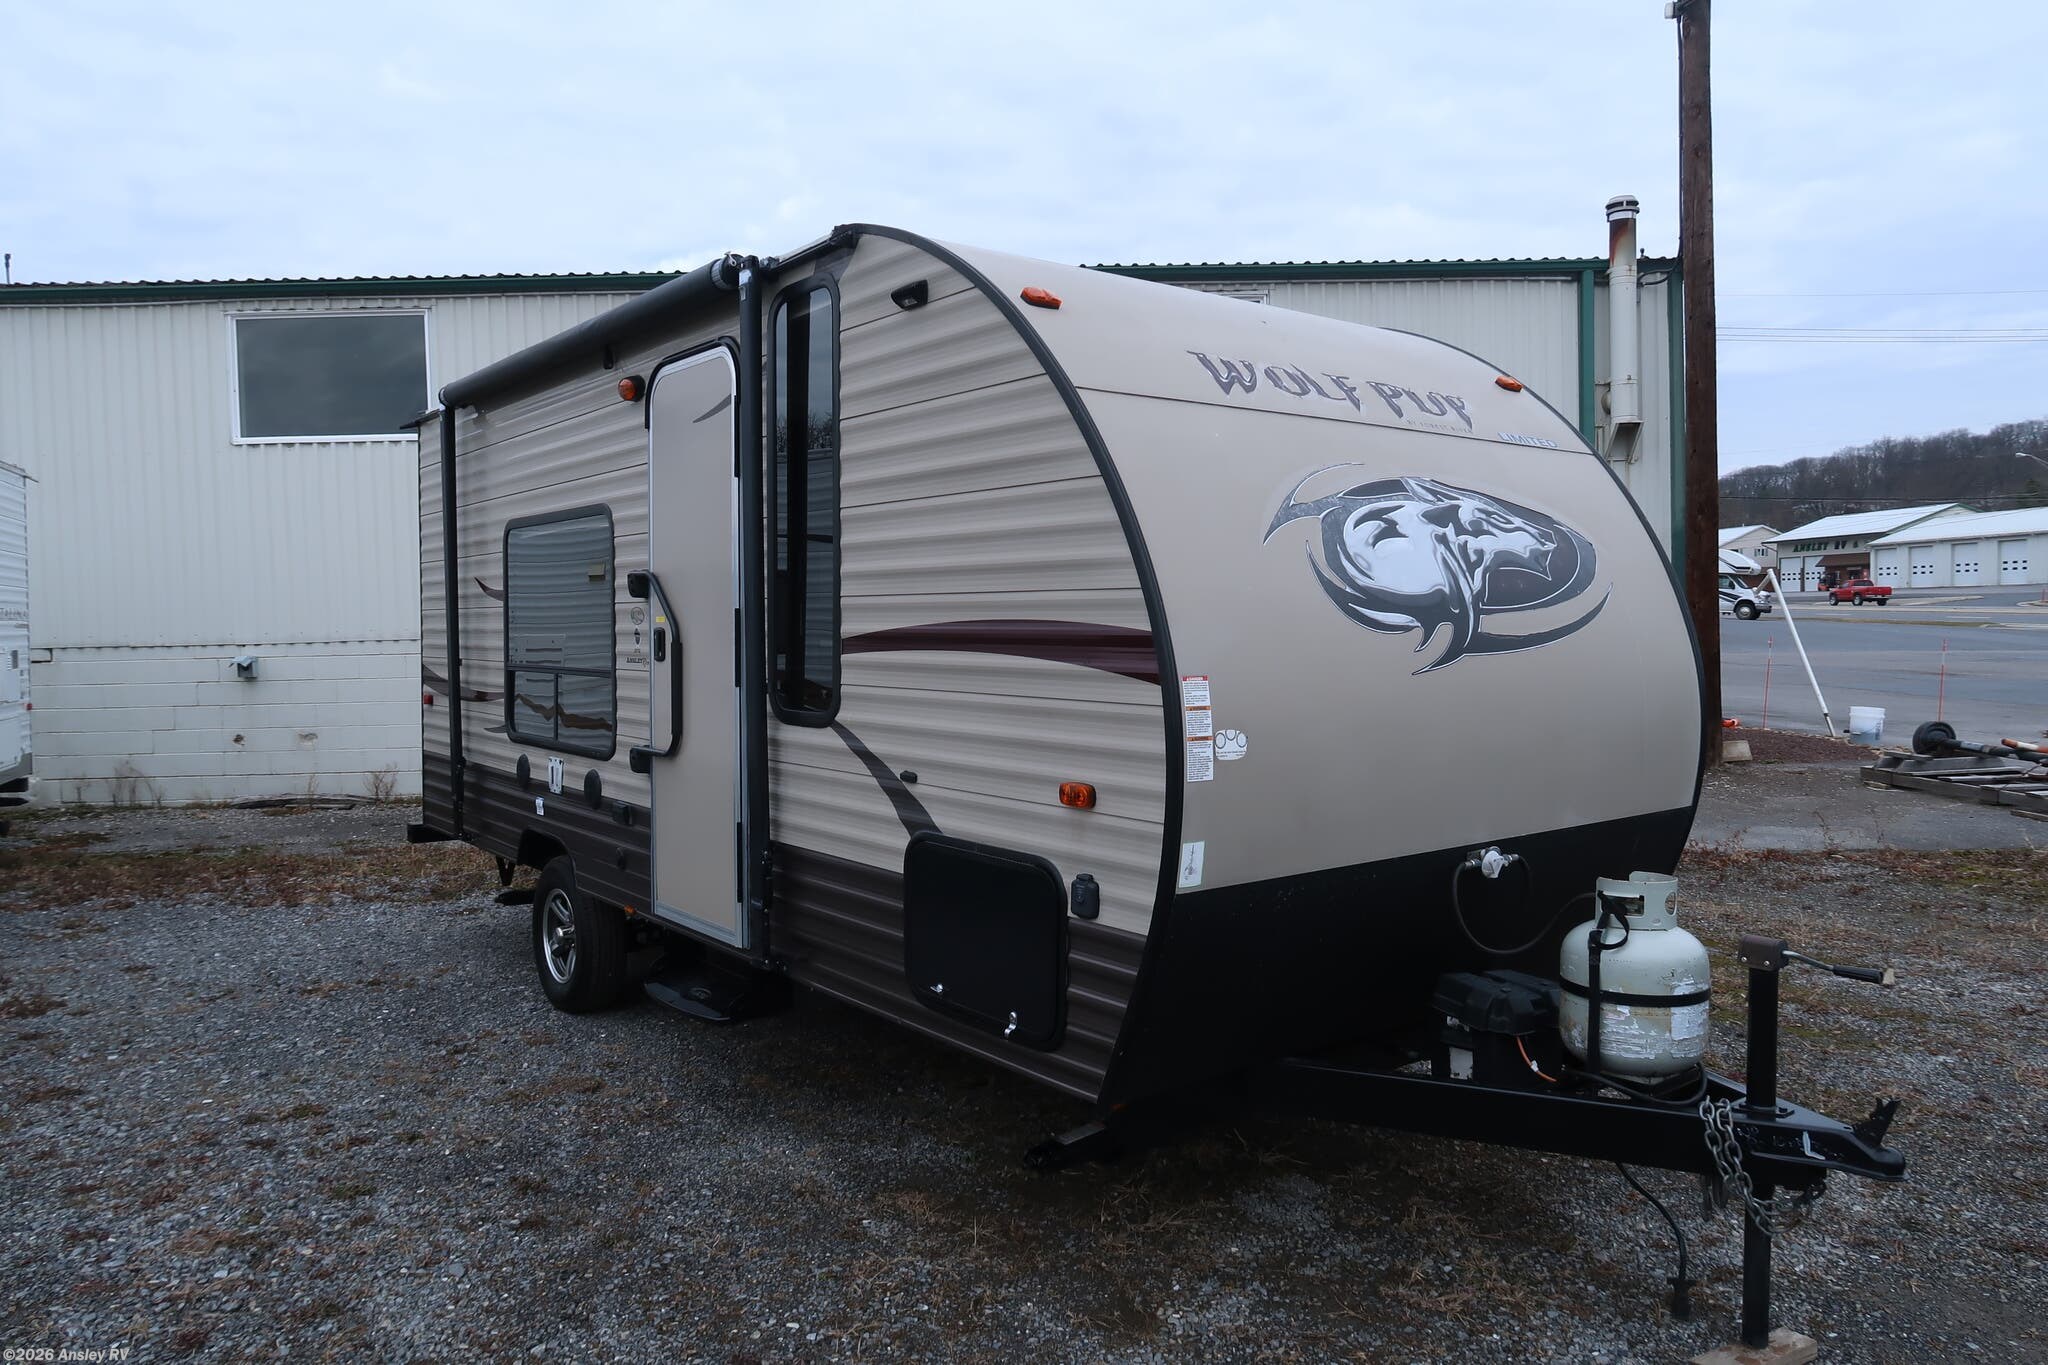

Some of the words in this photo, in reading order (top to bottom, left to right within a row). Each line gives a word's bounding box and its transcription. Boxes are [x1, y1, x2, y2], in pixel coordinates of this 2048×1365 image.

[1187, 350, 1361, 412] WOLF
[1366, 380, 1473, 431] PUP
[1497, 432, 1558, 448] LIMITED
